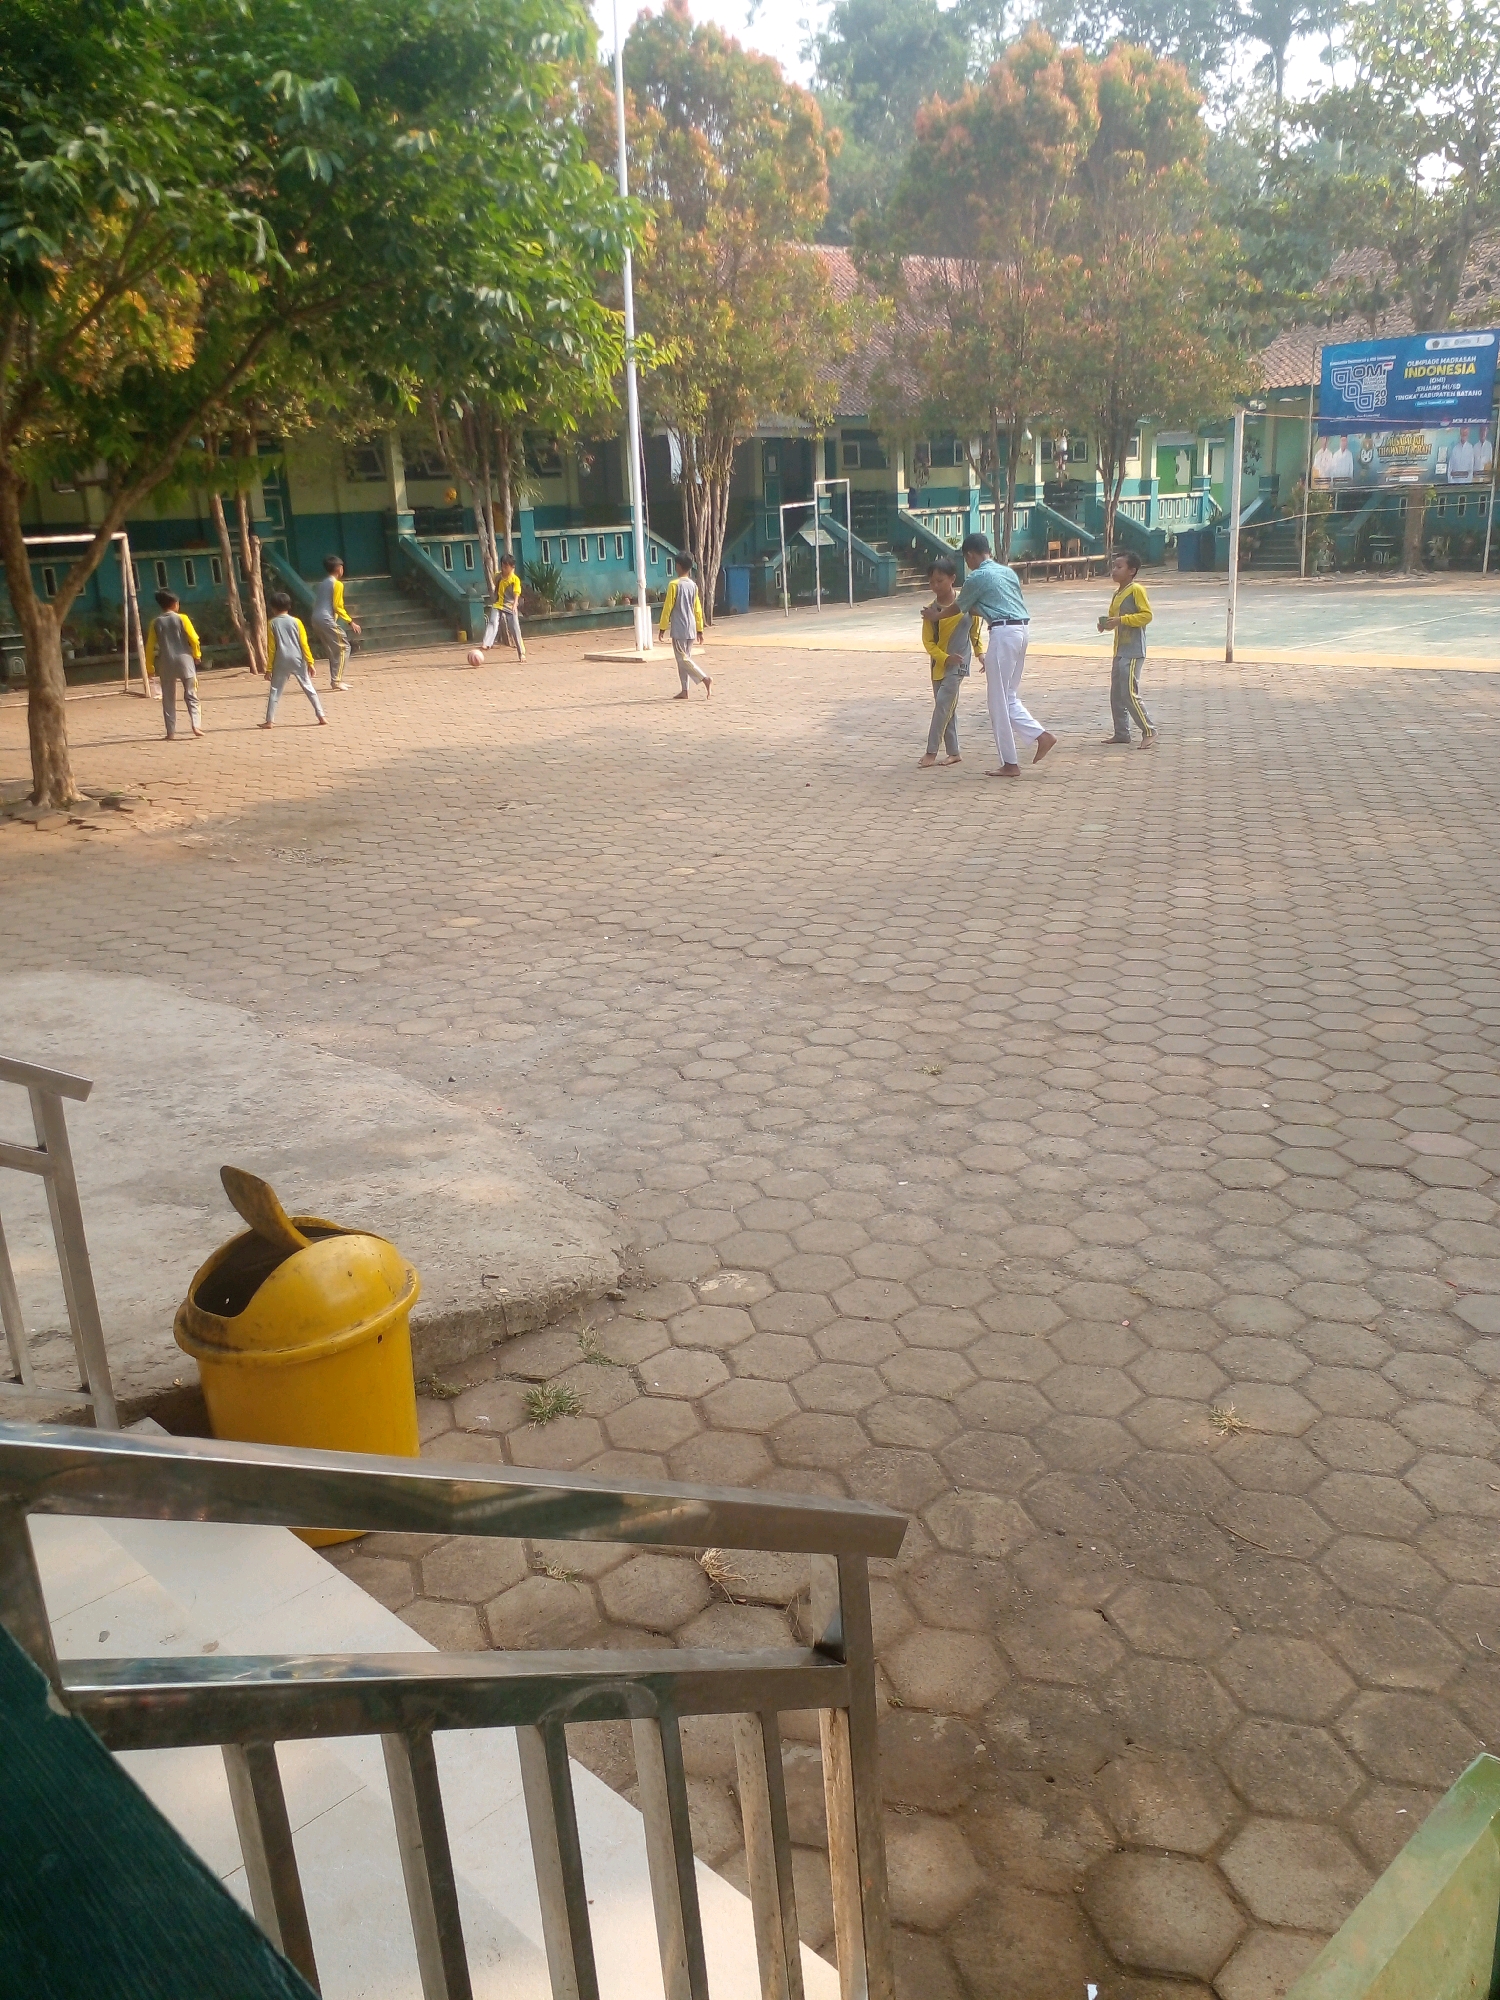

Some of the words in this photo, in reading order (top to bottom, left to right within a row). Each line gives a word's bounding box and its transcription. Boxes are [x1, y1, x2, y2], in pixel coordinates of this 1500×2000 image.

[1407, 358, 1440, 367] OLIMPIADE
[1440, 355, 1477, 364] MADRASAH
[1404, 362, 1476, 379] INDONESIA
[1375, 390, 1386, 398] 20
[1419, 391, 1456, 399] KABUPATEN
[1456, 389, 1482, 397] BATANG
